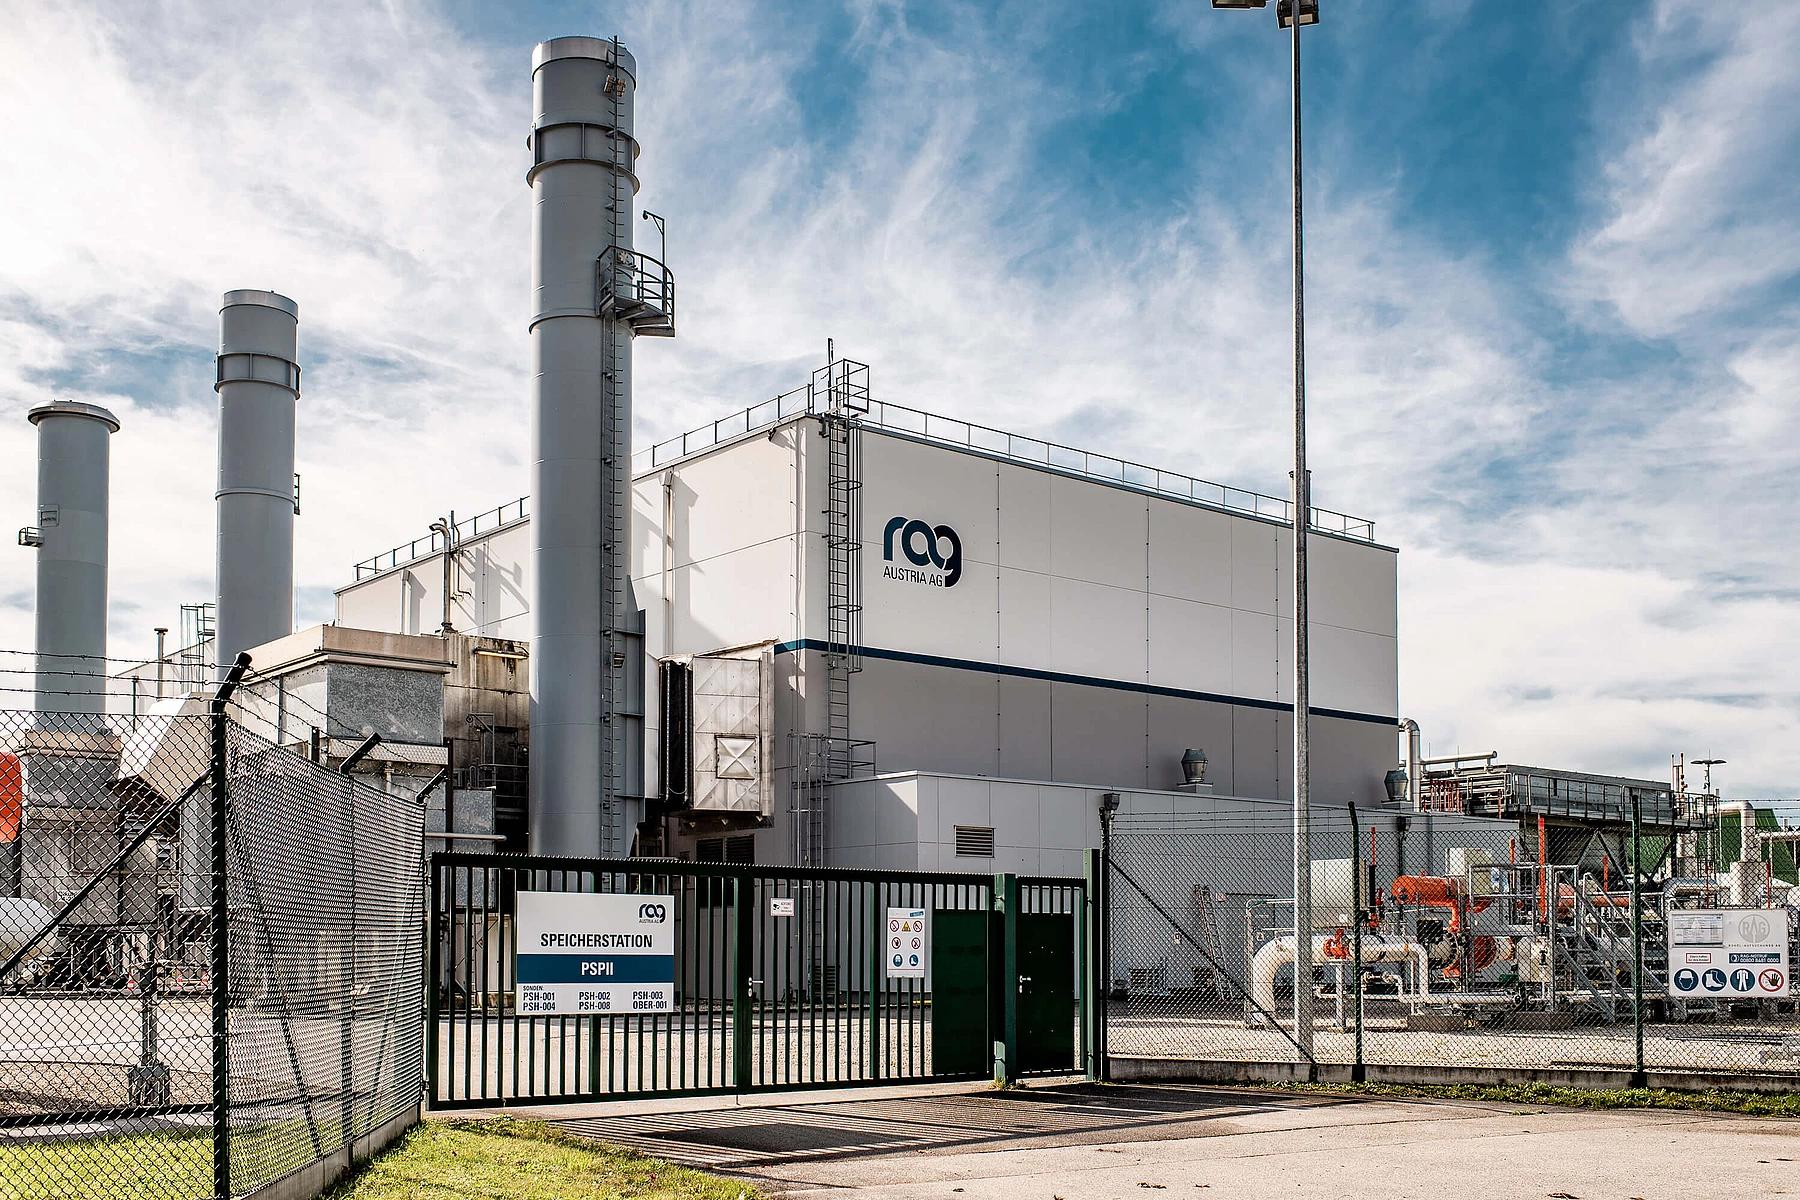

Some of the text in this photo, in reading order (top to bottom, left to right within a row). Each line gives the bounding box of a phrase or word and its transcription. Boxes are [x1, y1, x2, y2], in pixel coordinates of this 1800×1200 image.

[883, 566, 943, 587] AUSTRIA AG
[1742, 915, 1766, 935] RAG
[540, 932, 653, 948] SPEICHERSTATION
[581, 962, 614, 976] PSPII
[523, 992, 555, 1001] PSH-001
[579, 991, 611, 1001] PSH-002
[632, 991, 663, 1000] PSH-003
[523, 1002, 556, 1011] PSH-004
[632, 1000, 667, 1010] OBER-001
